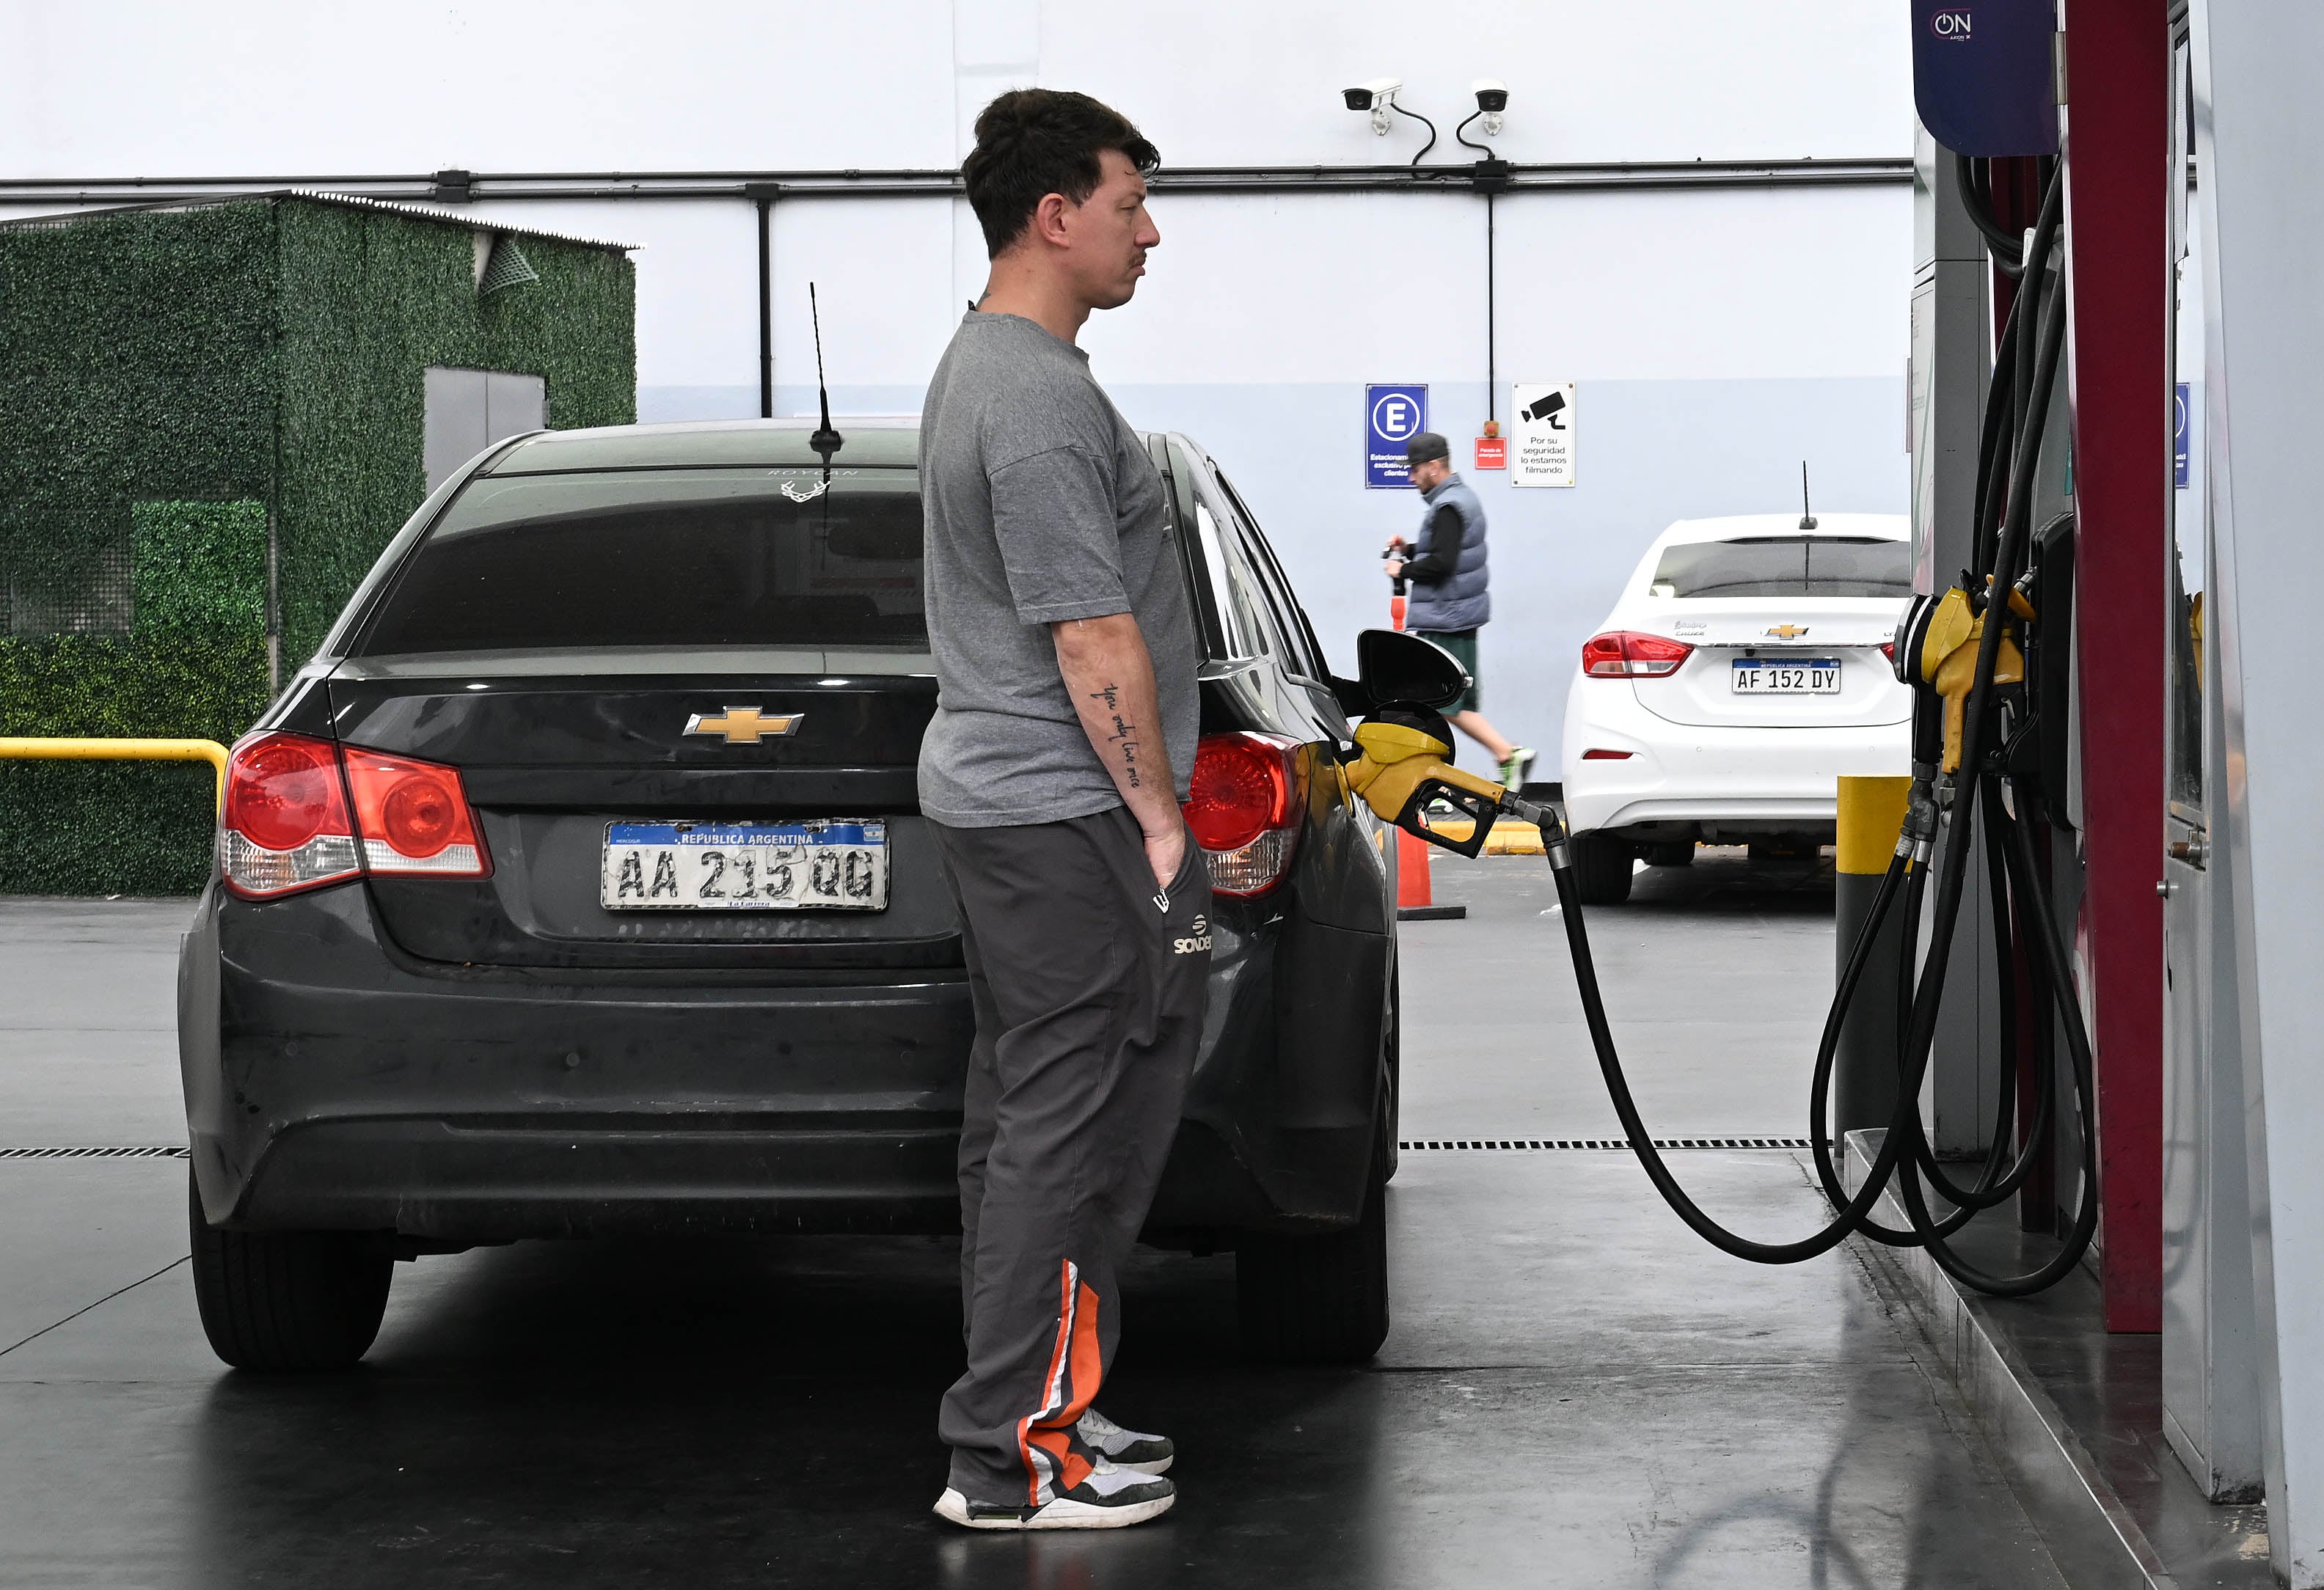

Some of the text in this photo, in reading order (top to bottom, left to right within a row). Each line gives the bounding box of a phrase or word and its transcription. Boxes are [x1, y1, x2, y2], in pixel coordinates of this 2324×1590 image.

[1934, 12, 1971, 34] ON
[1386, 403, 1406, 432] E
[1531, 436, 1545, 444] Por
[1523, 447, 1565, 455] seguridad
[1370, 453, 1408, 461] Estacionami
[1521, 456, 1567, 464] lo estamos
[1737, 670, 1835, 689] AF 152 DY
[748, 834, 814, 844] ARGENTINA
[617, 850, 679, 898] AA
[699, 849, 792, 899] 215
